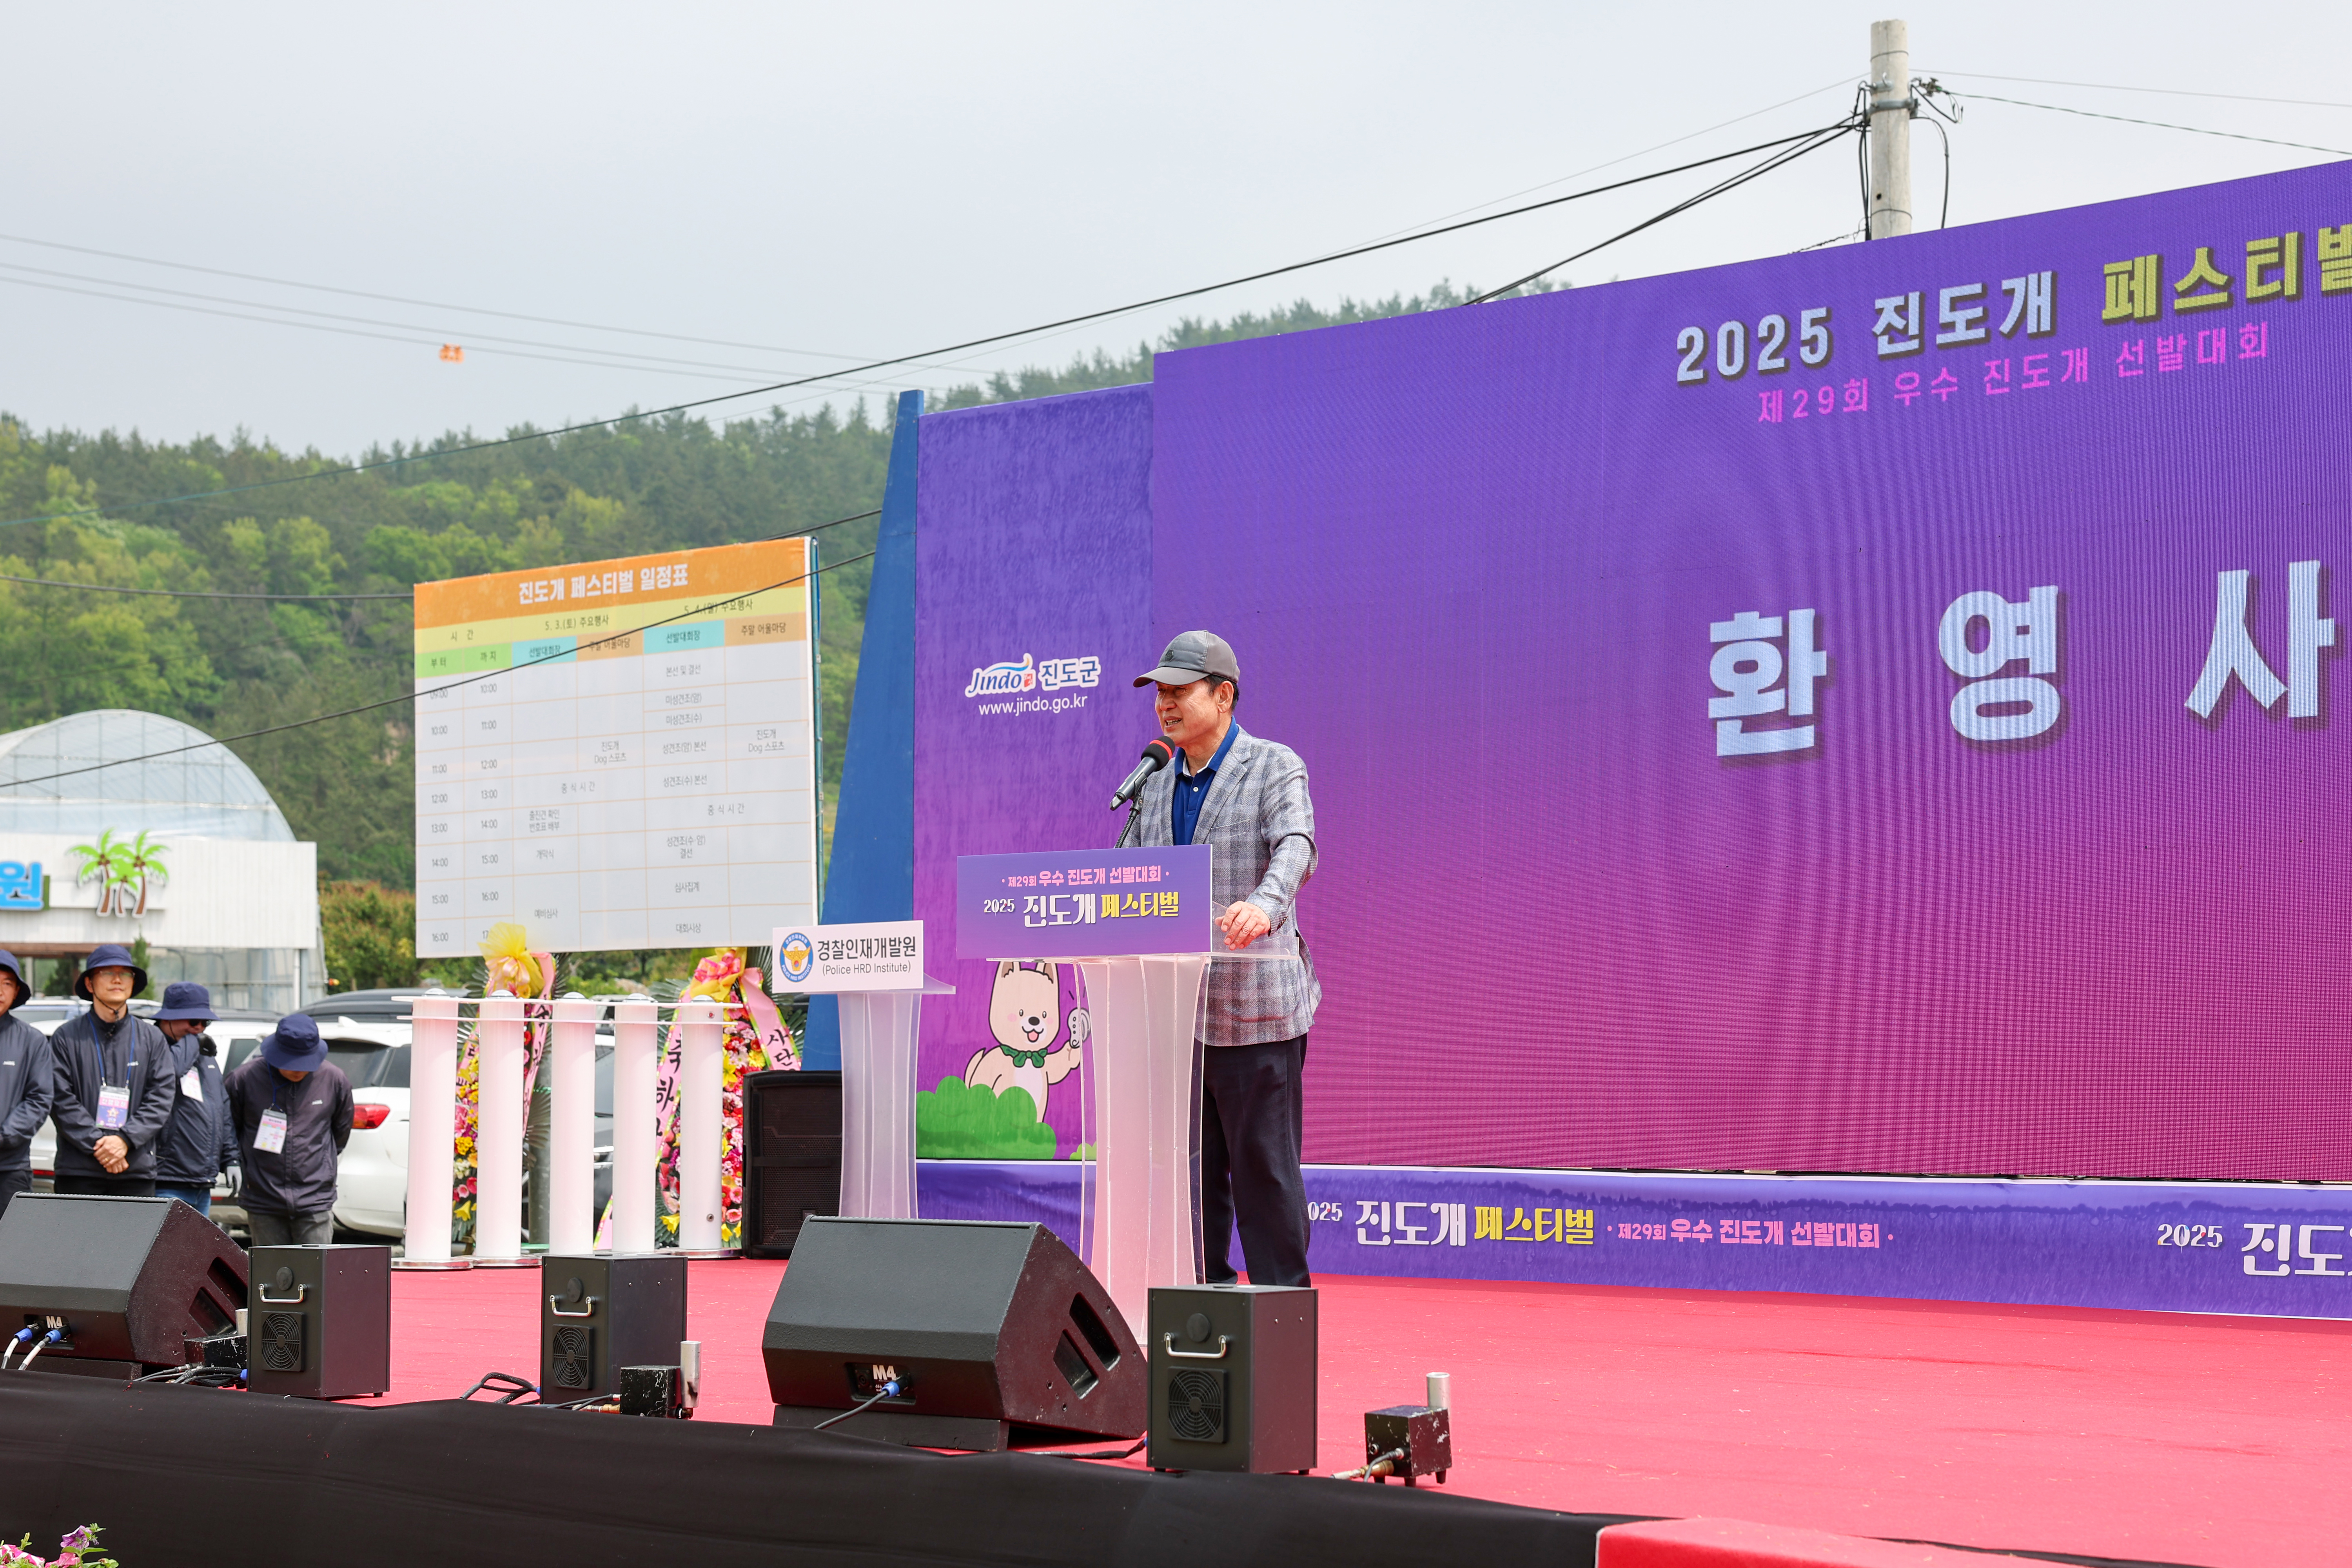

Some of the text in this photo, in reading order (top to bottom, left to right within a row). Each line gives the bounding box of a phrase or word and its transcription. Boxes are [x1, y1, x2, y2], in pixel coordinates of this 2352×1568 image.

[1677, 223, 2352, 382] 2025 진도개 페스티벌
[1758, 321, 2267, 423] 제29회 우수 진도개 선발대회
[519, 564, 688, 605] 진도개 페스티벌 일정표
[579, 615, 609, 628] 주요행사
[741, 622, 786, 635] 주말 어울마당
[666, 630, 701, 644] 선발대회장
[529, 644, 561, 658] 선발대회장
[1041, 660, 1098, 687] 진도군
[480, 684, 497, 693] 10:00
[978, 693, 1088, 717] www.jindo.go.kr
[431, 725, 448, 735] 10:00
[482, 720, 497, 730] 11:00
[757, 729, 777, 740] 진도개
[601, 741, 619, 752] 진도개
[748, 741, 785, 753] Dog 스포츠
[481, 759, 498, 770] 12:00
[594, 753, 626, 765] Dog 스포츠
[432, 764, 447, 774] 11:00
[431, 793, 448, 804] 12:00
[481, 789, 498, 800] 13:00
[431, 823, 448, 833] 13:00
[481, 819, 498, 829] 14:00
[432, 858, 448, 867] 14:00
[481, 854, 498, 864] 15:00
[1008, 865, 1161, 887] 제29회 우수 진도개 선발대회
[432, 894, 449, 904] 15:00
[481, 891, 499, 901] 16:00
[984, 891, 1179, 927] 2025 진도개 페스티벌
[432, 932, 449, 942] 16:00
[817, 936, 916, 961] 경찰인재개발원
[822, 960, 911, 976] (Police HRD Institute)
[1307, 1200, 1593, 1246] 025 진도개 페스티벌
[1617, 1218, 1880, 1249] 제29회 우수 진도개 선발대회
[2157, 1223, 2352, 1277] 2025 진도
[46, 1316, 63, 1329] M4
[873, 1364, 897, 1381] M4
